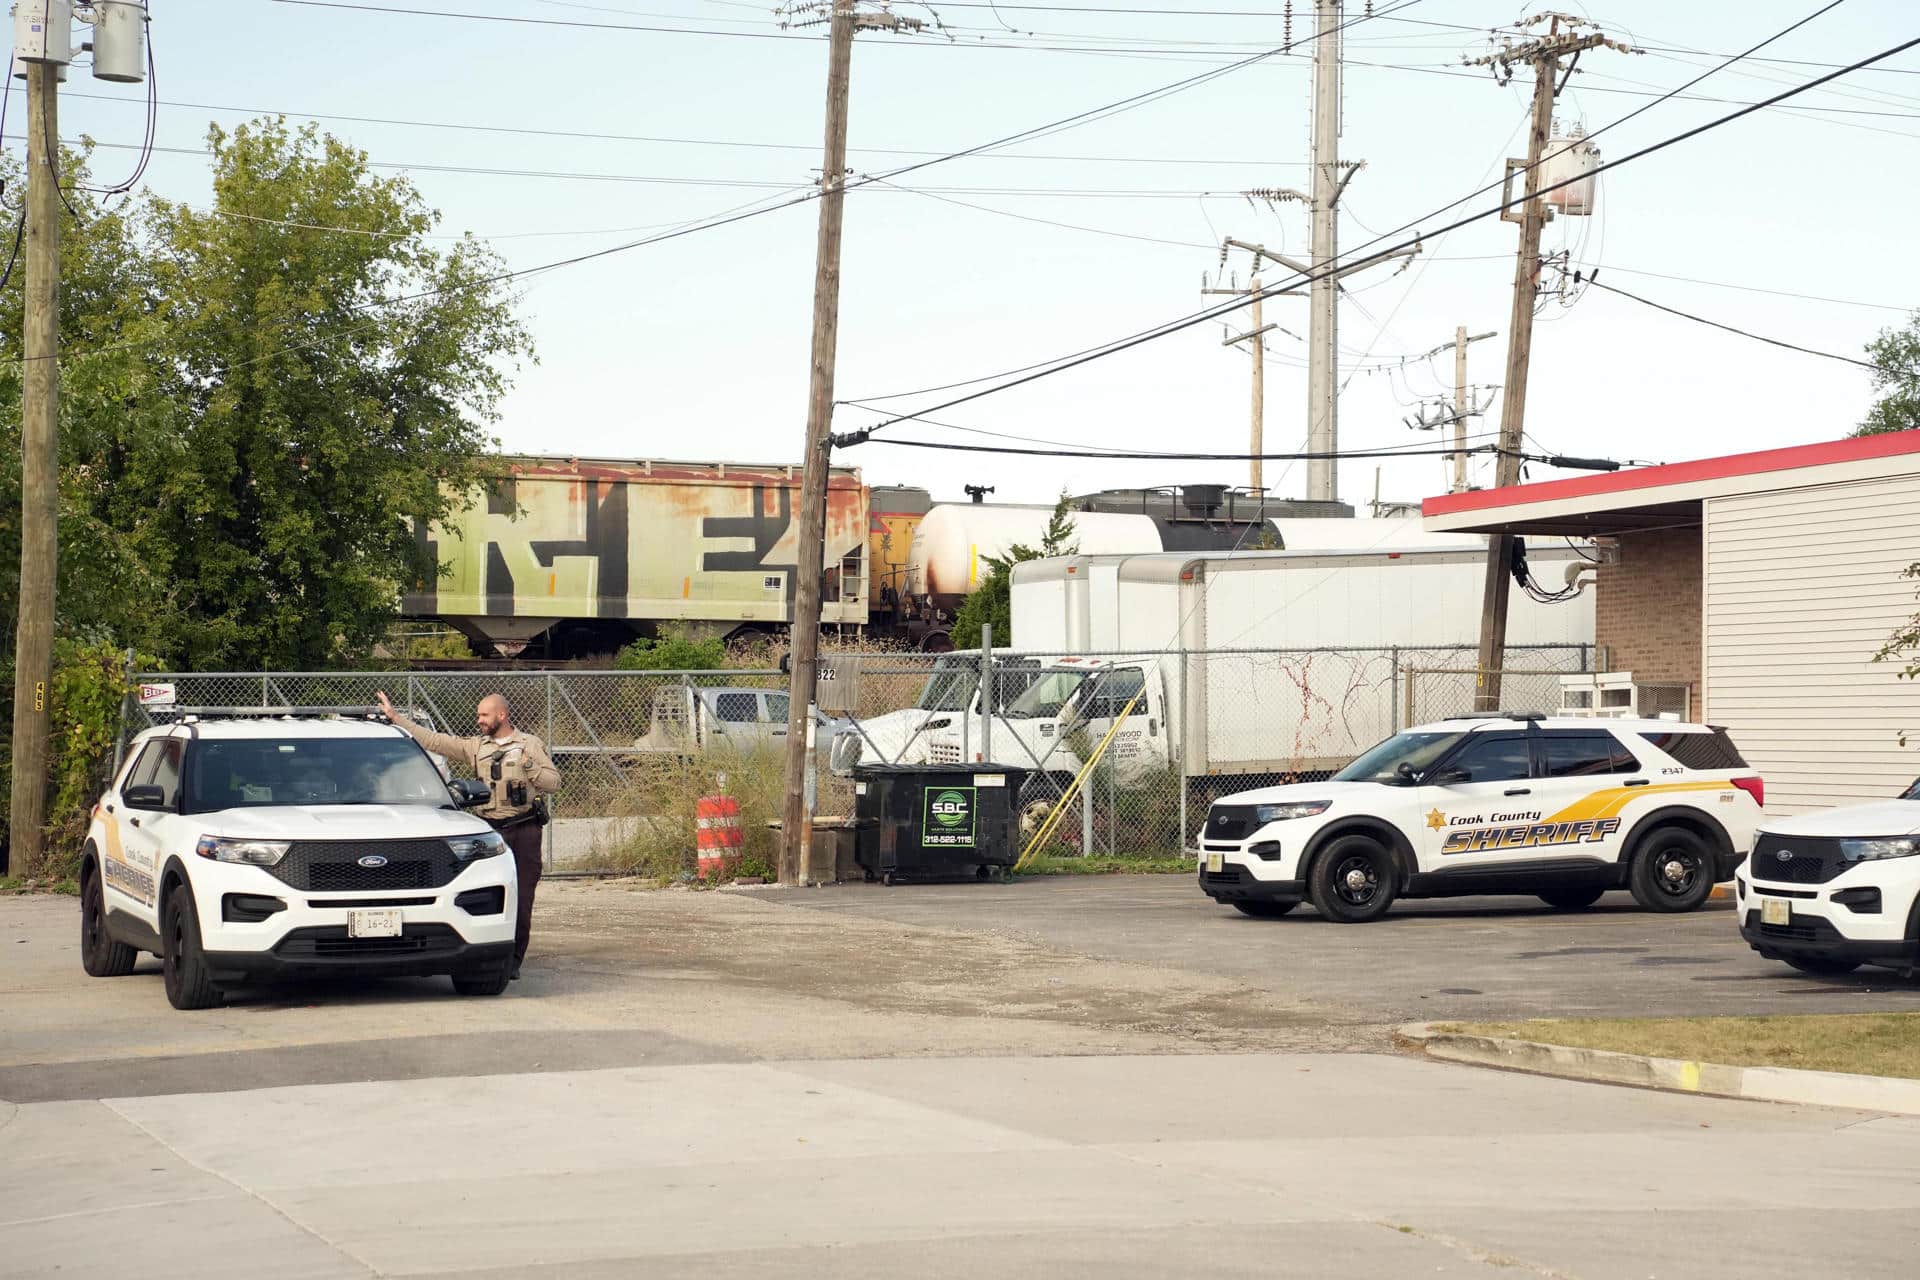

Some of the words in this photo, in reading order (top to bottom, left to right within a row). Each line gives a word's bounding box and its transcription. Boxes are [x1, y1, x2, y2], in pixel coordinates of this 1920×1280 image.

[1096, 730, 1142, 739] HALWOOD
[1450, 813, 1484, 826] Cook
[1490, 810, 1542, 823] County
[1441, 817, 1621, 855] SHERIFF
